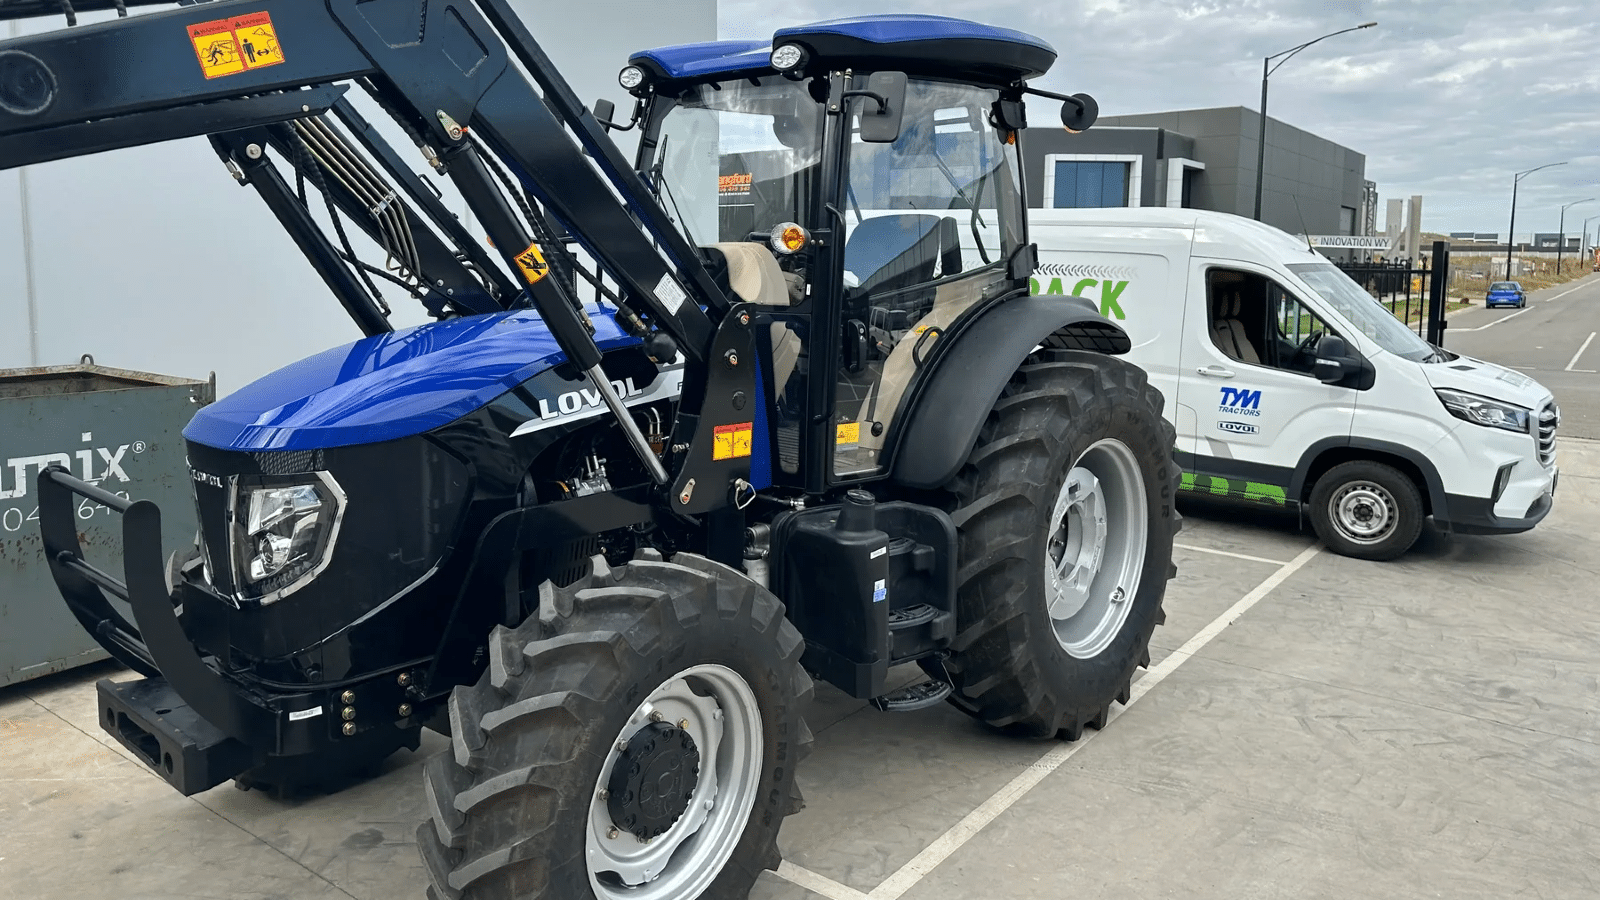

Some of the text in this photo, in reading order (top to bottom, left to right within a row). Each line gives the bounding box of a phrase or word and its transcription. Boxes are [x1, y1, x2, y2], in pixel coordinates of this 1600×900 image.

[1320, 236, 1390, 248] INNOVATION WY
[1220, 387, 1261, 409] TYM
[1218, 405, 1261, 417] TRACTORS
[1219, 423, 1258, 434] LOVOL
